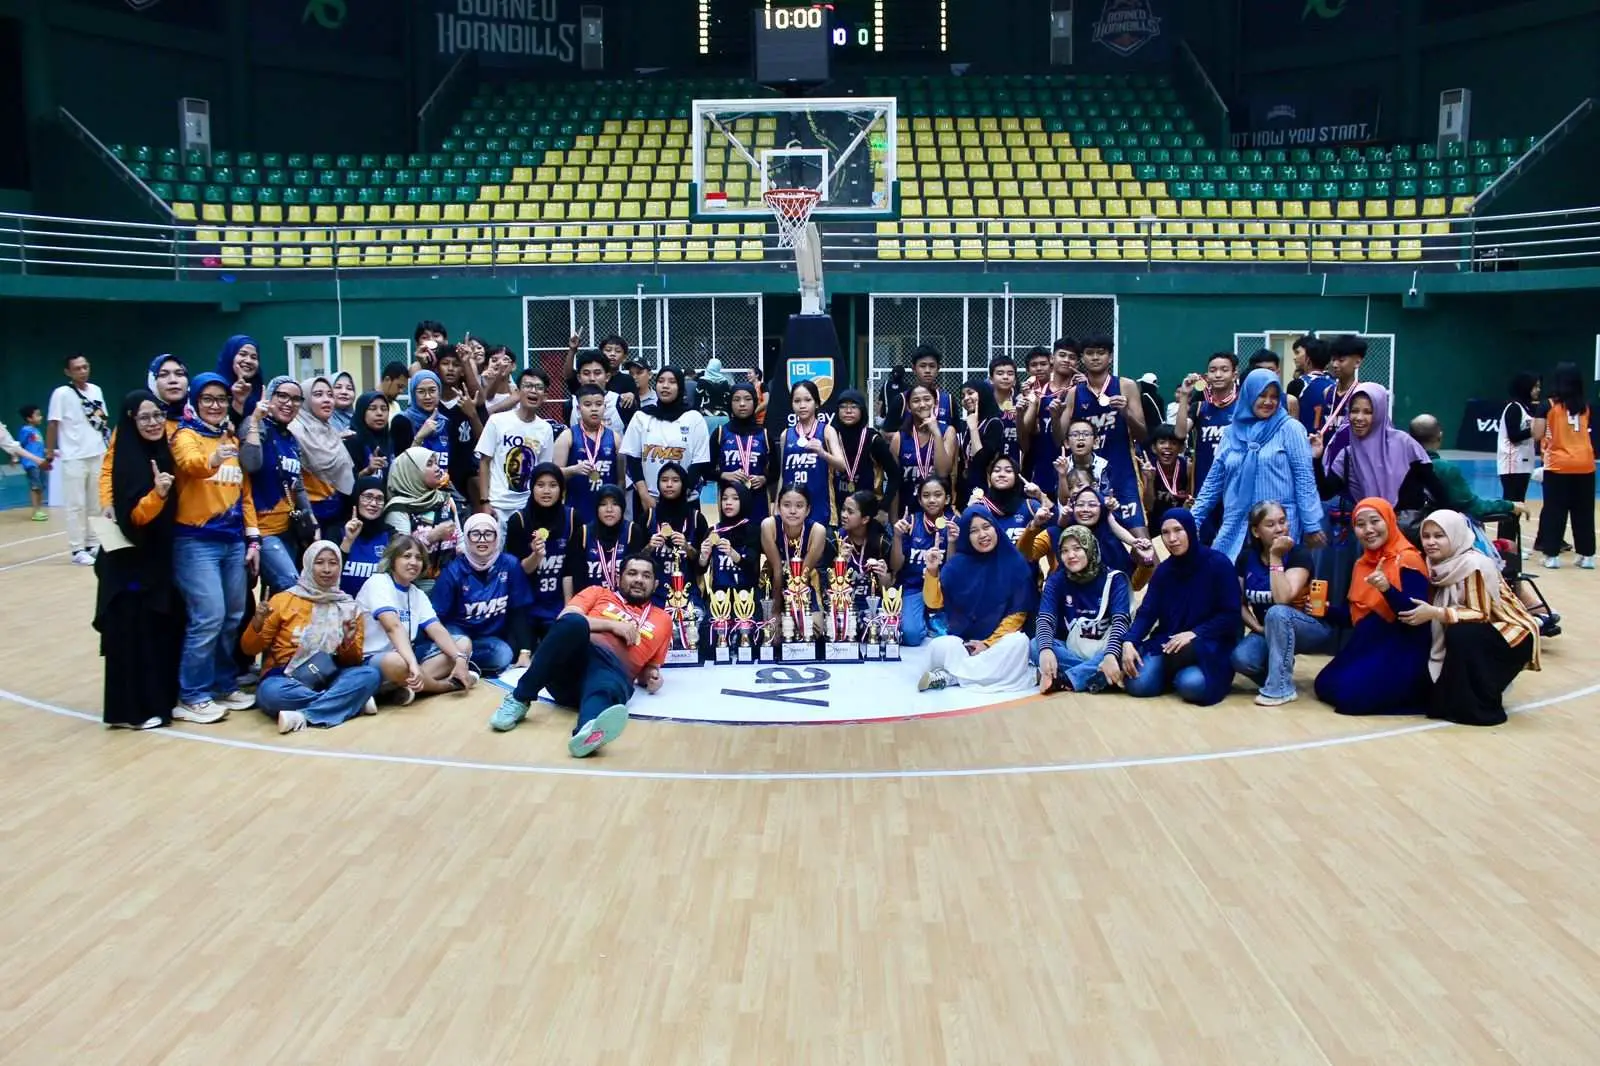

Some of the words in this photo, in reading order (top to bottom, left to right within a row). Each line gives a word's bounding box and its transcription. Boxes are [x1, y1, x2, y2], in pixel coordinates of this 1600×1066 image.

[764, 8, 822, 30] 10:00
[436, 13, 577, 62] HORNBILLS
[1288, 127, 1316, 145] YOU
[791, 363, 817, 376] IBL
[787, 412, 836, 427] gay
[643, 443, 686, 461] YMS
[786, 453, 817, 466] YMS
[1120, 503, 1137, 520] 27
[540, 577, 558, 592] 33
[464, 595, 509, 615] YMS
